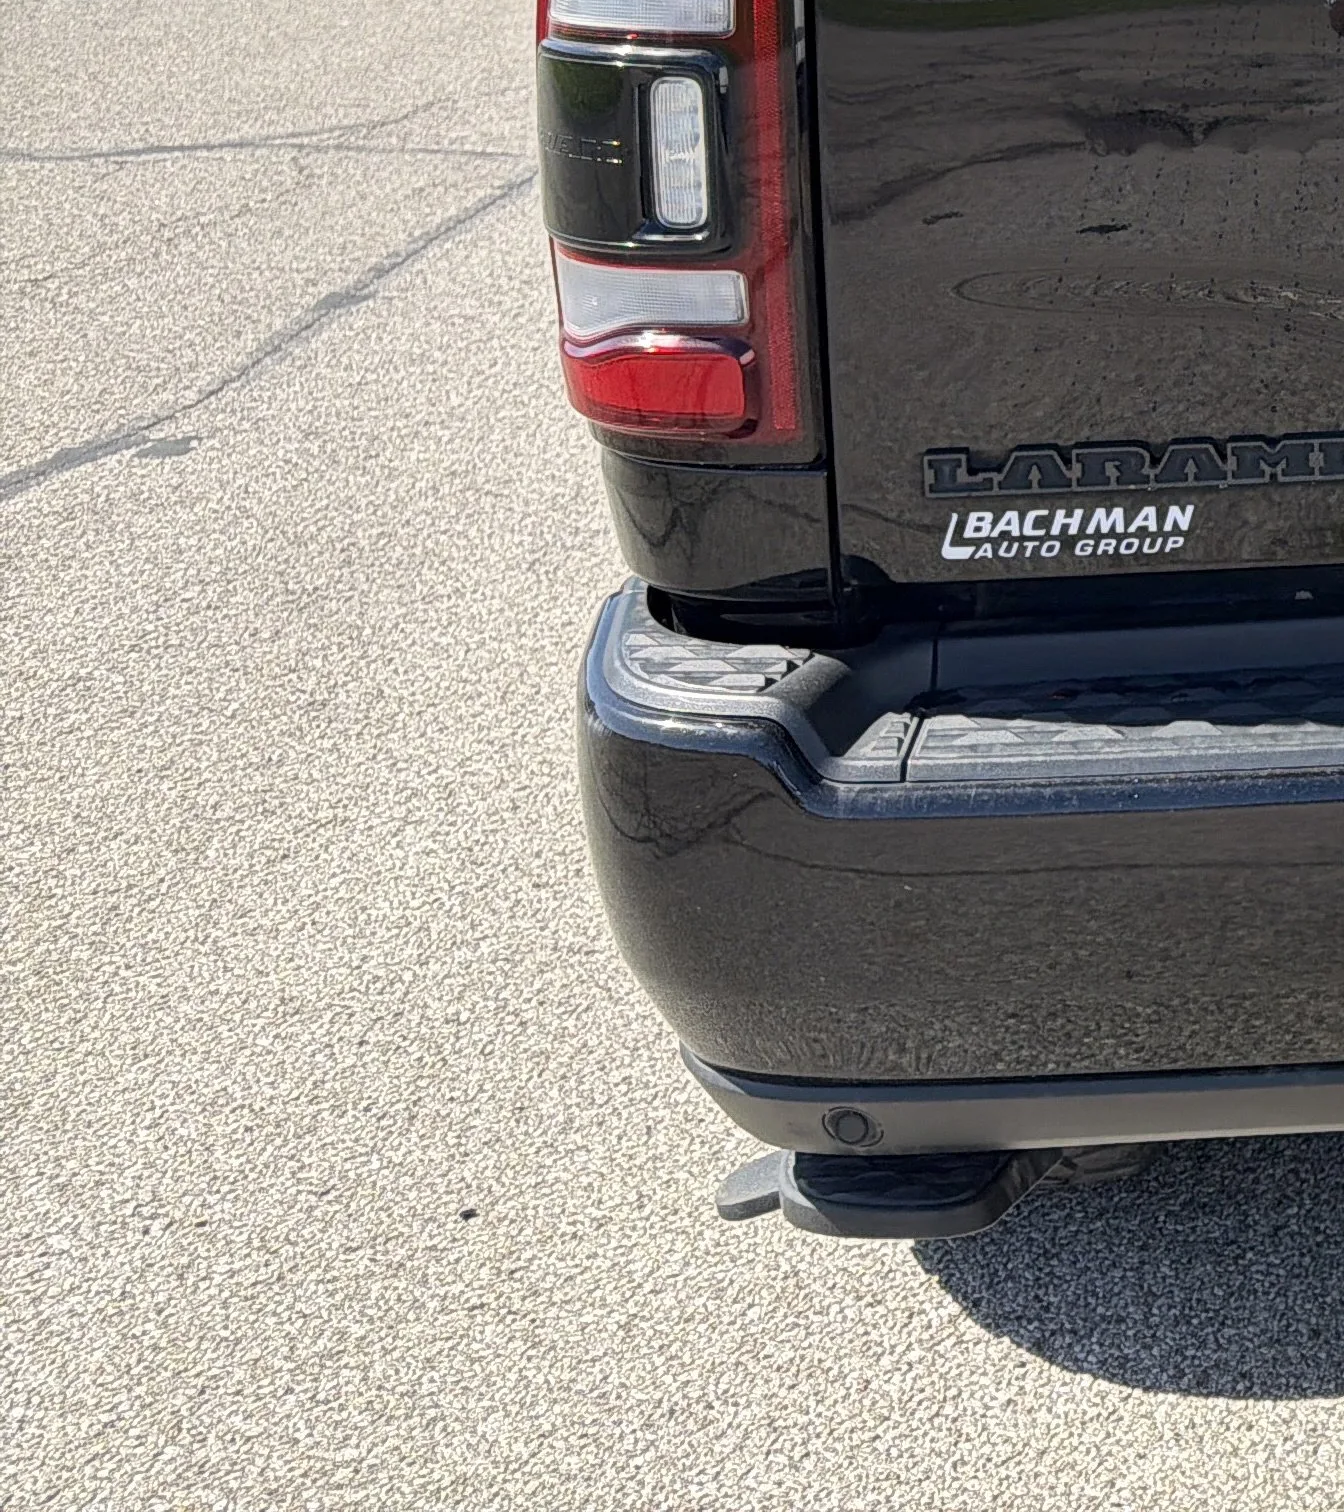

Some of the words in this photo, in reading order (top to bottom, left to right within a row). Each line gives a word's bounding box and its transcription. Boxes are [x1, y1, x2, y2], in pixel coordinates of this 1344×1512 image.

[963, 505, 1195, 538] BACHMAN
[973, 541, 1061, 559] AUTO
[1074, 536, 1185, 556] GROUP
